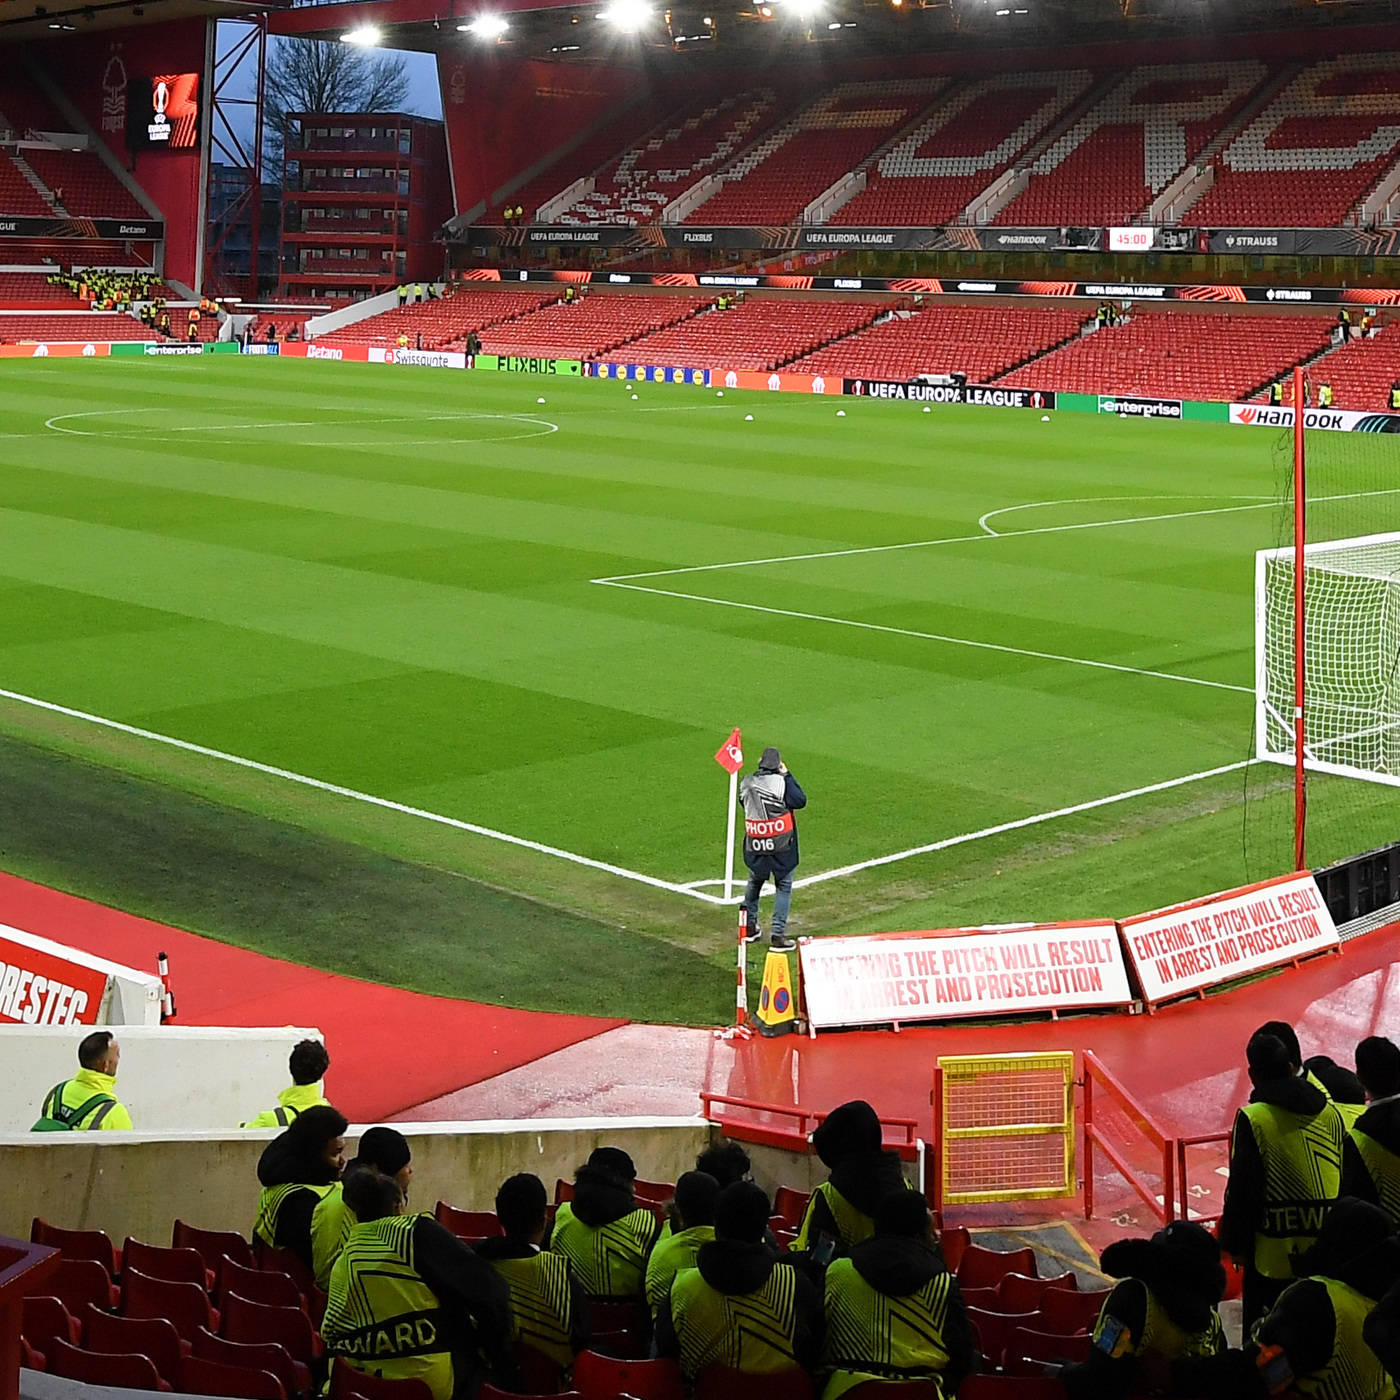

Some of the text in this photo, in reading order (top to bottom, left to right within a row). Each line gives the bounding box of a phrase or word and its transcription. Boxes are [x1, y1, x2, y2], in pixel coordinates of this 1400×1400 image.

[806, 234, 894, 244] UEFA EUROPA LEAGUE
[1236, 236, 1278, 246] STRAUSS
[306, 344, 343, 360] Betano
[395, 351, 449, 368] Swissquote
[868, 381, 1023, 407] UEFA EUROPA LEAGUE
[1101, 399, 1180, 417] enterprise
[745, 819, 785, 835] PHOTO
[752, 838, 775, 851] 016
[1132, 887, 1321, 961] ENTERING THE PITCH WILL RESULT
[1155, 913, 1322, 984] IN ARREST AND PROSECUTION
[904, 950, 941, 978] THE
[943, 945, 998, 975] PITCH
[999, 941, 1046, 970] WILL
[1047, 937, 1115, 966] RESULT
[936, 976, 972, 1004] AND
[973, 966, 1103, 1002] PROSECUTION
